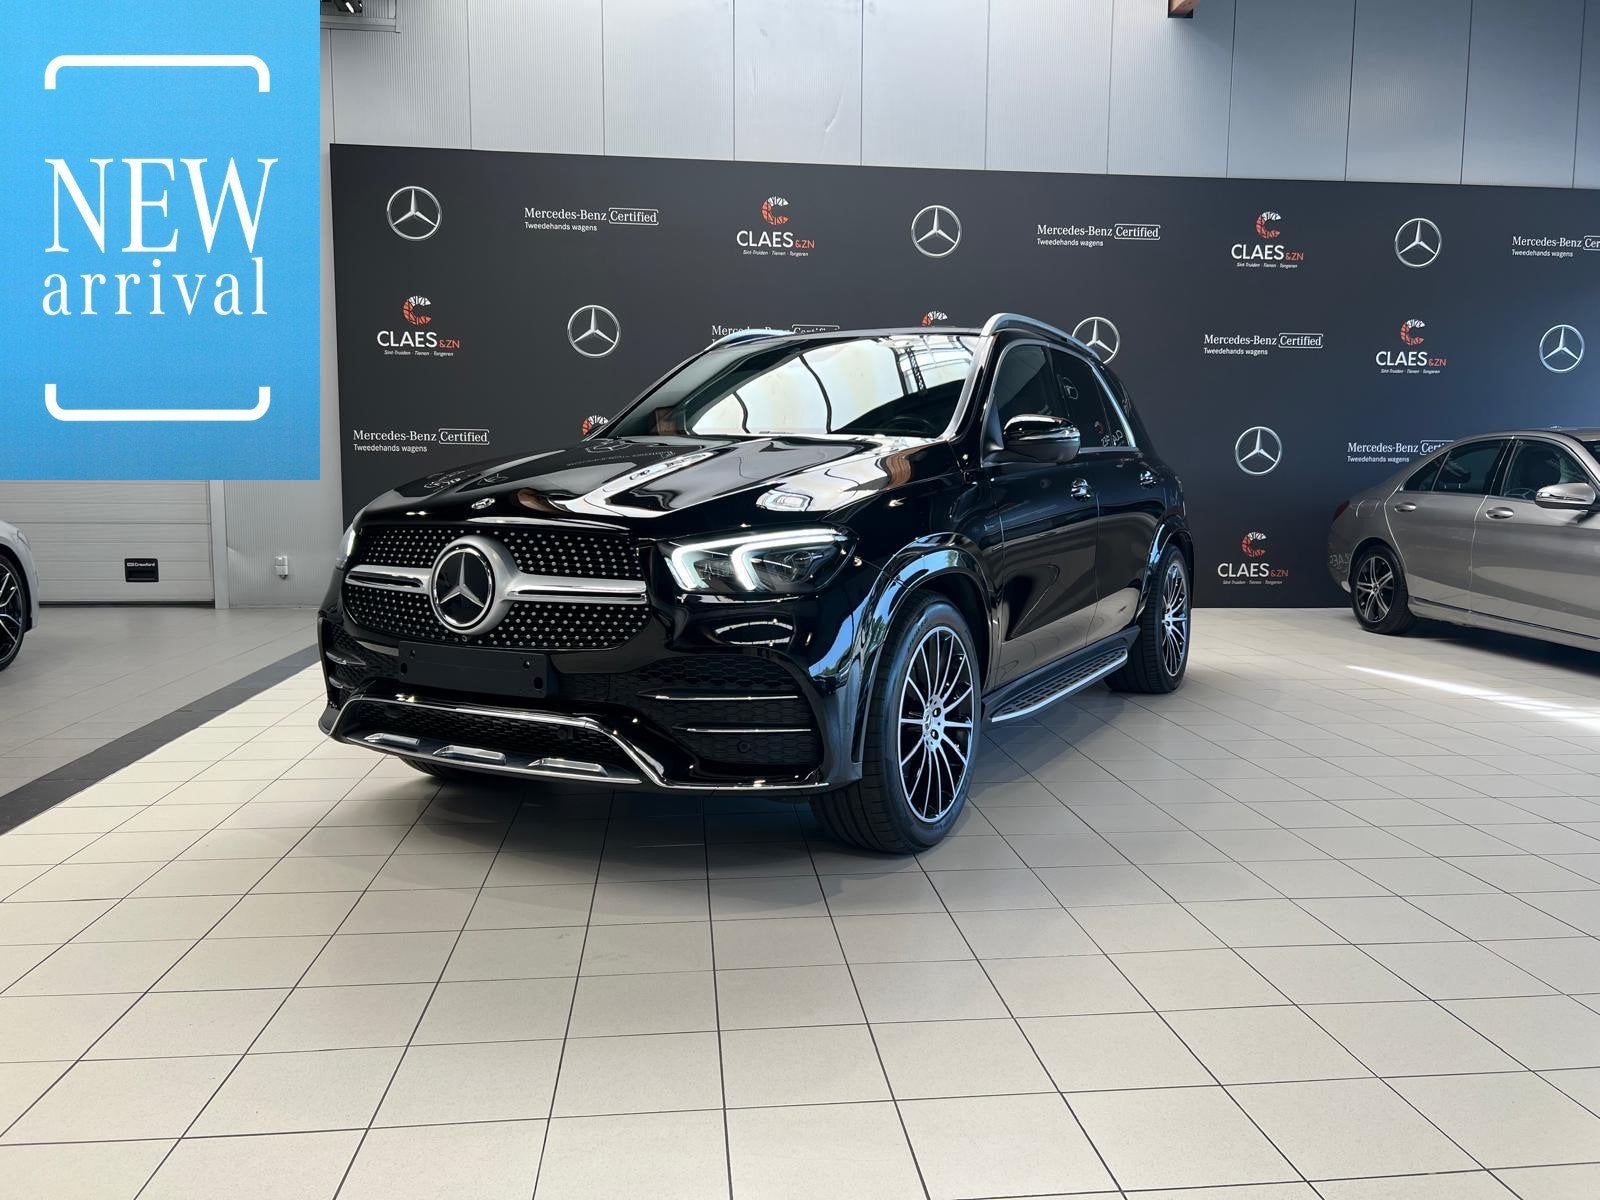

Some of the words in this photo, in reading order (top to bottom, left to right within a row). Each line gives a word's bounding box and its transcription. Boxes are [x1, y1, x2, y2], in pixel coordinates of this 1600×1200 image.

[524, 207, 607, 221] Mercedes-Benz
[610, 210, 657, 223] Certified
[524, 222, 571, 231] Tweedehands
[571, 225, 598, 233] wagens
[1037, 224, 1113, 237] Mercedes-Benz
[1115, 226, 1159, 238] Certified
[1037, 238, 1079, 246] Tweedehands
[1080, 240, 1104, 248] wagens
[1512, 236, 1582, 248] Mercedes-Benz
[1511, 248, 1551, 257] Tweedehands
[1203, 334, 1277, 346] Mercedes-Benz
[1279, 335, 1322, 346] Certified
[1203, 347, 1244, 355] Tweedehands
[1245, 349, 1269, 357] wagens
[353, 430, 437, 441] Mercedes-Benz
[440, 431, 488, 442] Certified
[353, 443, 400, 452] Tweedehands
[401, 445, 428, 453] wagens
[1347, 442, 1419, 453] Mercedes-Benz
[1347, 455, 1387, 463] Tweedehands
